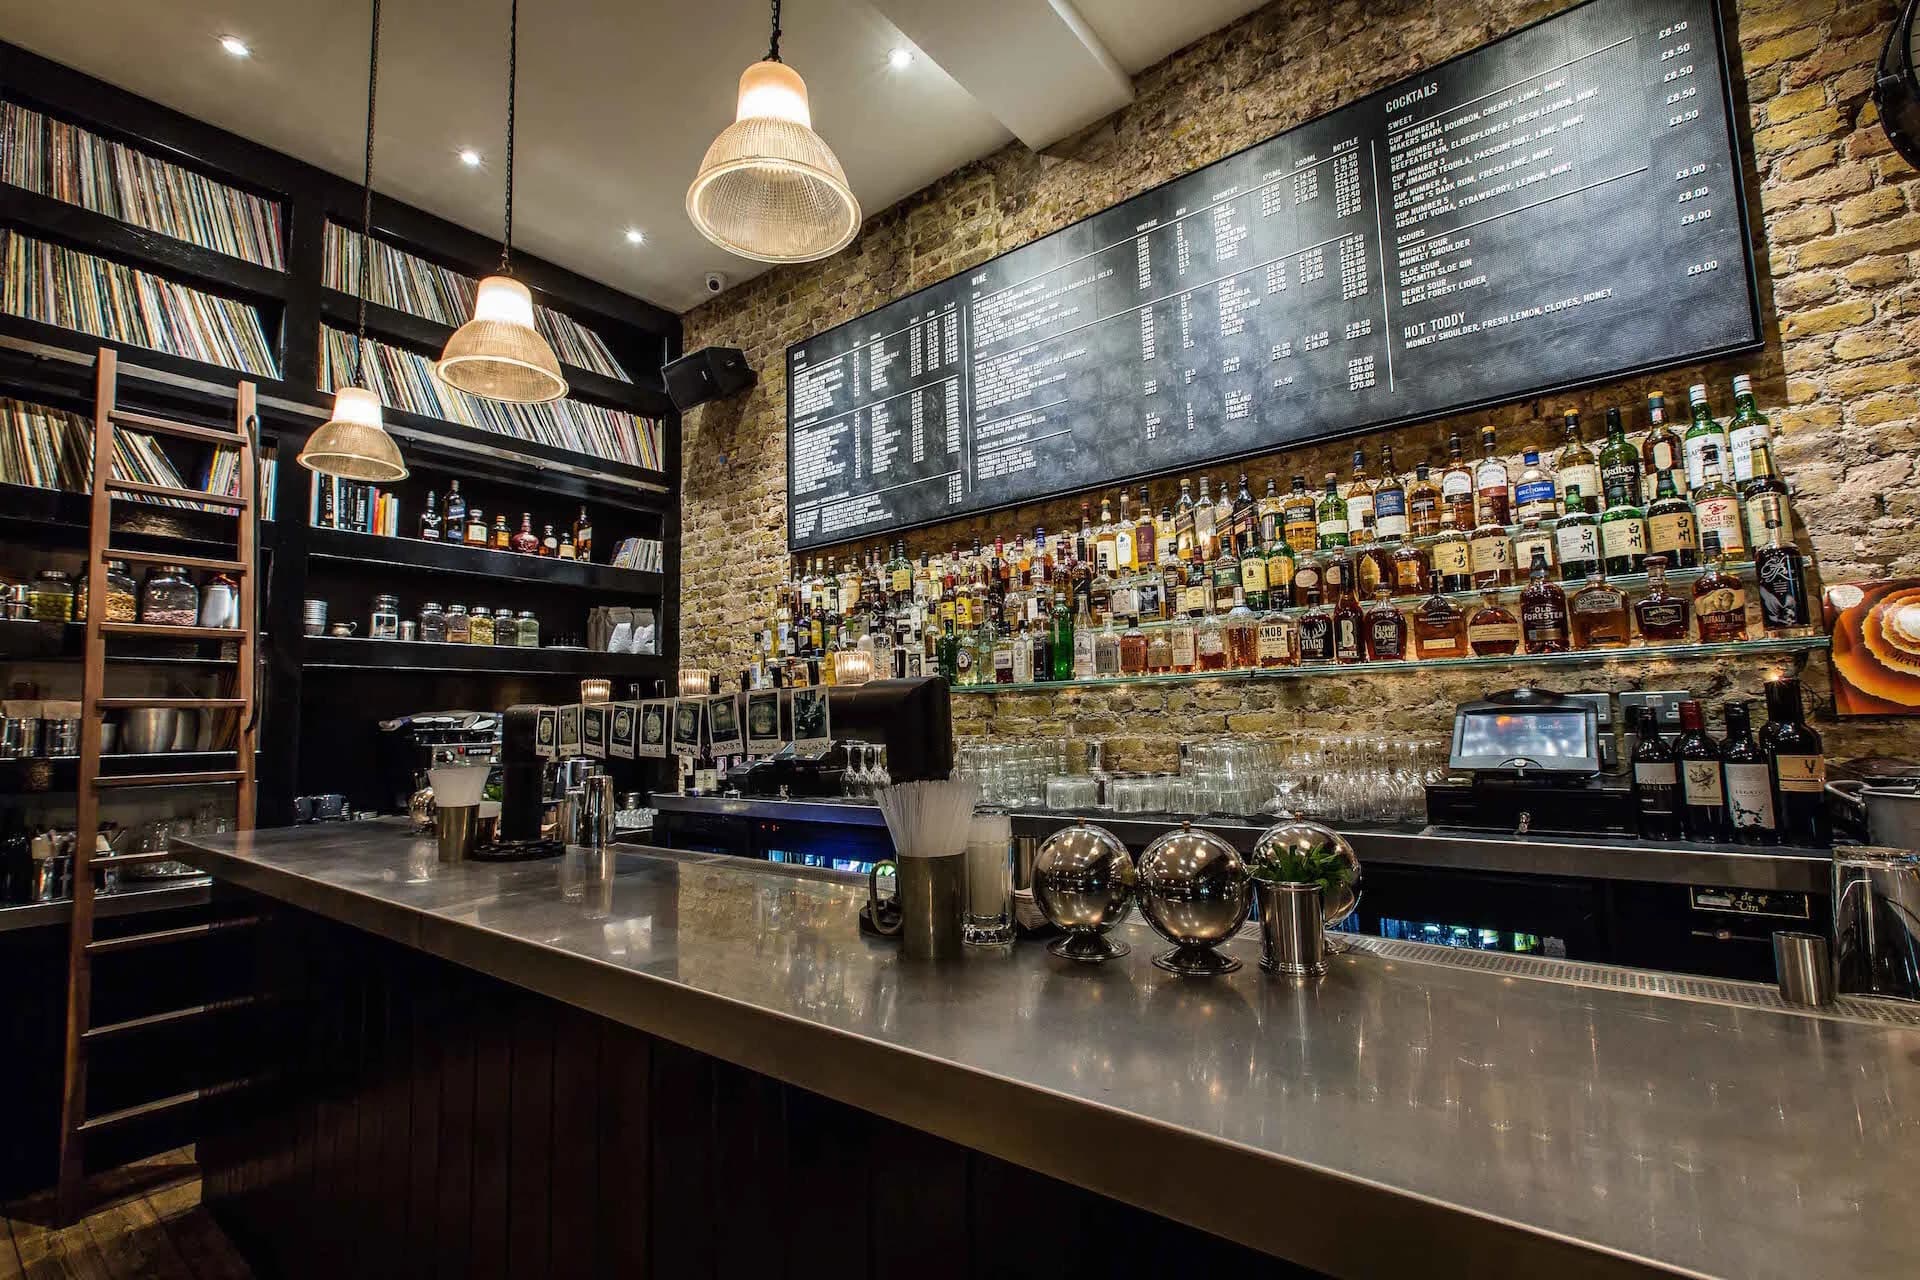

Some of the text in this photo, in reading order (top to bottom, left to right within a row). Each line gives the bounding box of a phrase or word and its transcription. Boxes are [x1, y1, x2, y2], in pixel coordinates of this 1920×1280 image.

[1385, 82, 1438, 113] COCKTAILS
[1387, 115, 1413, 131] SWEET
[1388, 134, 1403, 146] CUP
[1404, 122, 1435, 139] NUMBER
[1389, 136, 1419, 153] MAKERS
[1421, 127, 1442, 141] MARK
[1444, 112, 1480, 132] BOURBON,
[1482, 98, 1515, 117] CHERRY,
[1332, 137, 1358, 152] BOTTLE
[1390, 138, 1443, 164] CUP NUMBER 2
[1391, 151, 1432, 172] BEEFEATER
[1434, 144, 1448, 156] GIN,
[1512, 111, 1538, 126] FRESH
[1391, 172, 1406, 183] CUP
[1407, 160, 1438, 177] NUMBER
[1392, 182, 1401, 191] EL
[1404, 169, 1436, 187] JIMADOR
[1438, 156, 1472, 174] TEQUILA,
[1435, 182, 1455, 195] DARK
[1456, 175, 1476, 188] RUM,
[1478, 165, 1504, 180] FRESH
[1532, 148, 1553, 162] MINT
[1393, 177, 1447, 202] CUP NUMBER 4
[1395, 211, 1430, 229] ABSOLUT
[1430, 202, 1456, 217] VODKA,
[1458, 183, 1513, 208] STRAWBERRY,
[1550, 163, 1571, 177] MINT
[1394, 210, 1409, 221] CUP
[1410, 199, 1442, 215] NUMBER
[1398, 238, 1448, 259] WHISKY SOUR
[1399, 239, 1470, 267] MONKEY SHOULDER
[1399, 261, 1440, 279] SLOE SOUR
[1400, 259, 1472, 286] SIPSMITH SLOE GIN
[1401, 279, 1446, 298] BERRY SOUR
[1402, 293, 1426, 306] BLACK
[1427, 284, 1456, 299] FOREST
[1404, 312, 1465, 338] HOT TODDY
[1406, 289, 1612, 349] MONKEY SHOULDER, FRESH LEMON, CLOVES, HONEY
[1523, 611, 1564, 621] FORESTER
[1259, 626, 1282, 638] KNOB
[1735, 901, 1760, 912] Vin
